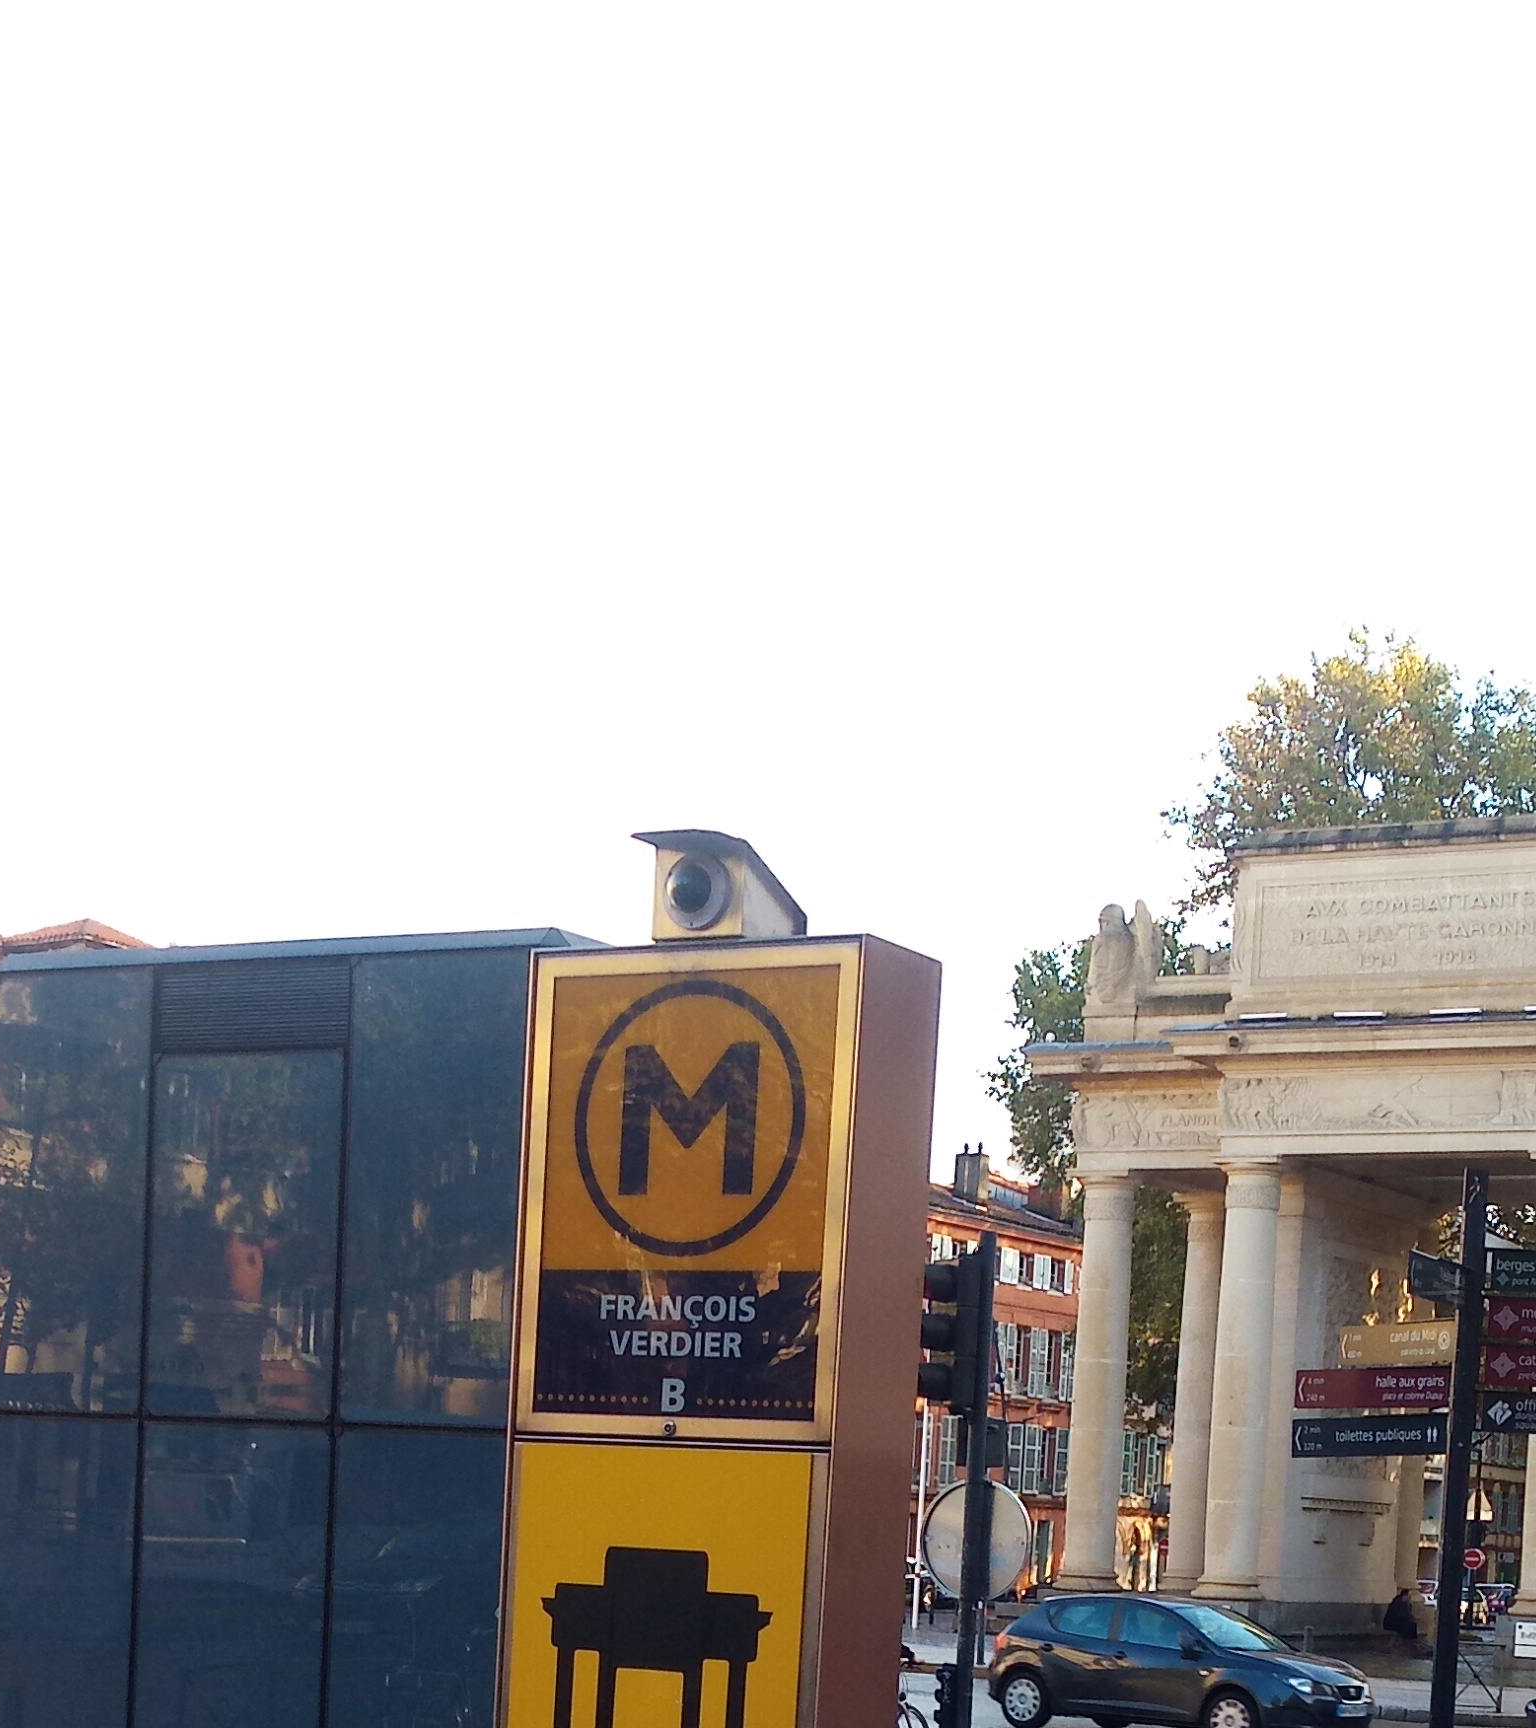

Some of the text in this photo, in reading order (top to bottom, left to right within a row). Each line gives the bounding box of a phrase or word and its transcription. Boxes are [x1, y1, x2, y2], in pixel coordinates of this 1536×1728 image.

[1360, 890, 1536, 916] COMBATTANTS
[1321, 926, 1349, 944] LA
[618, 1041, 760, 1196] M
[1496, 1258, 1535, 1275] berges
[599, 1294, 757, 1329] FRANÇOIS
[610, 1330, 742, 1359] VERDIER
[659, 1378, 686, 1413] B
[1376, 1375, 1445, 1390] halle aux grains
[1335, 1428, 1422, 1444] toilettes publiques
